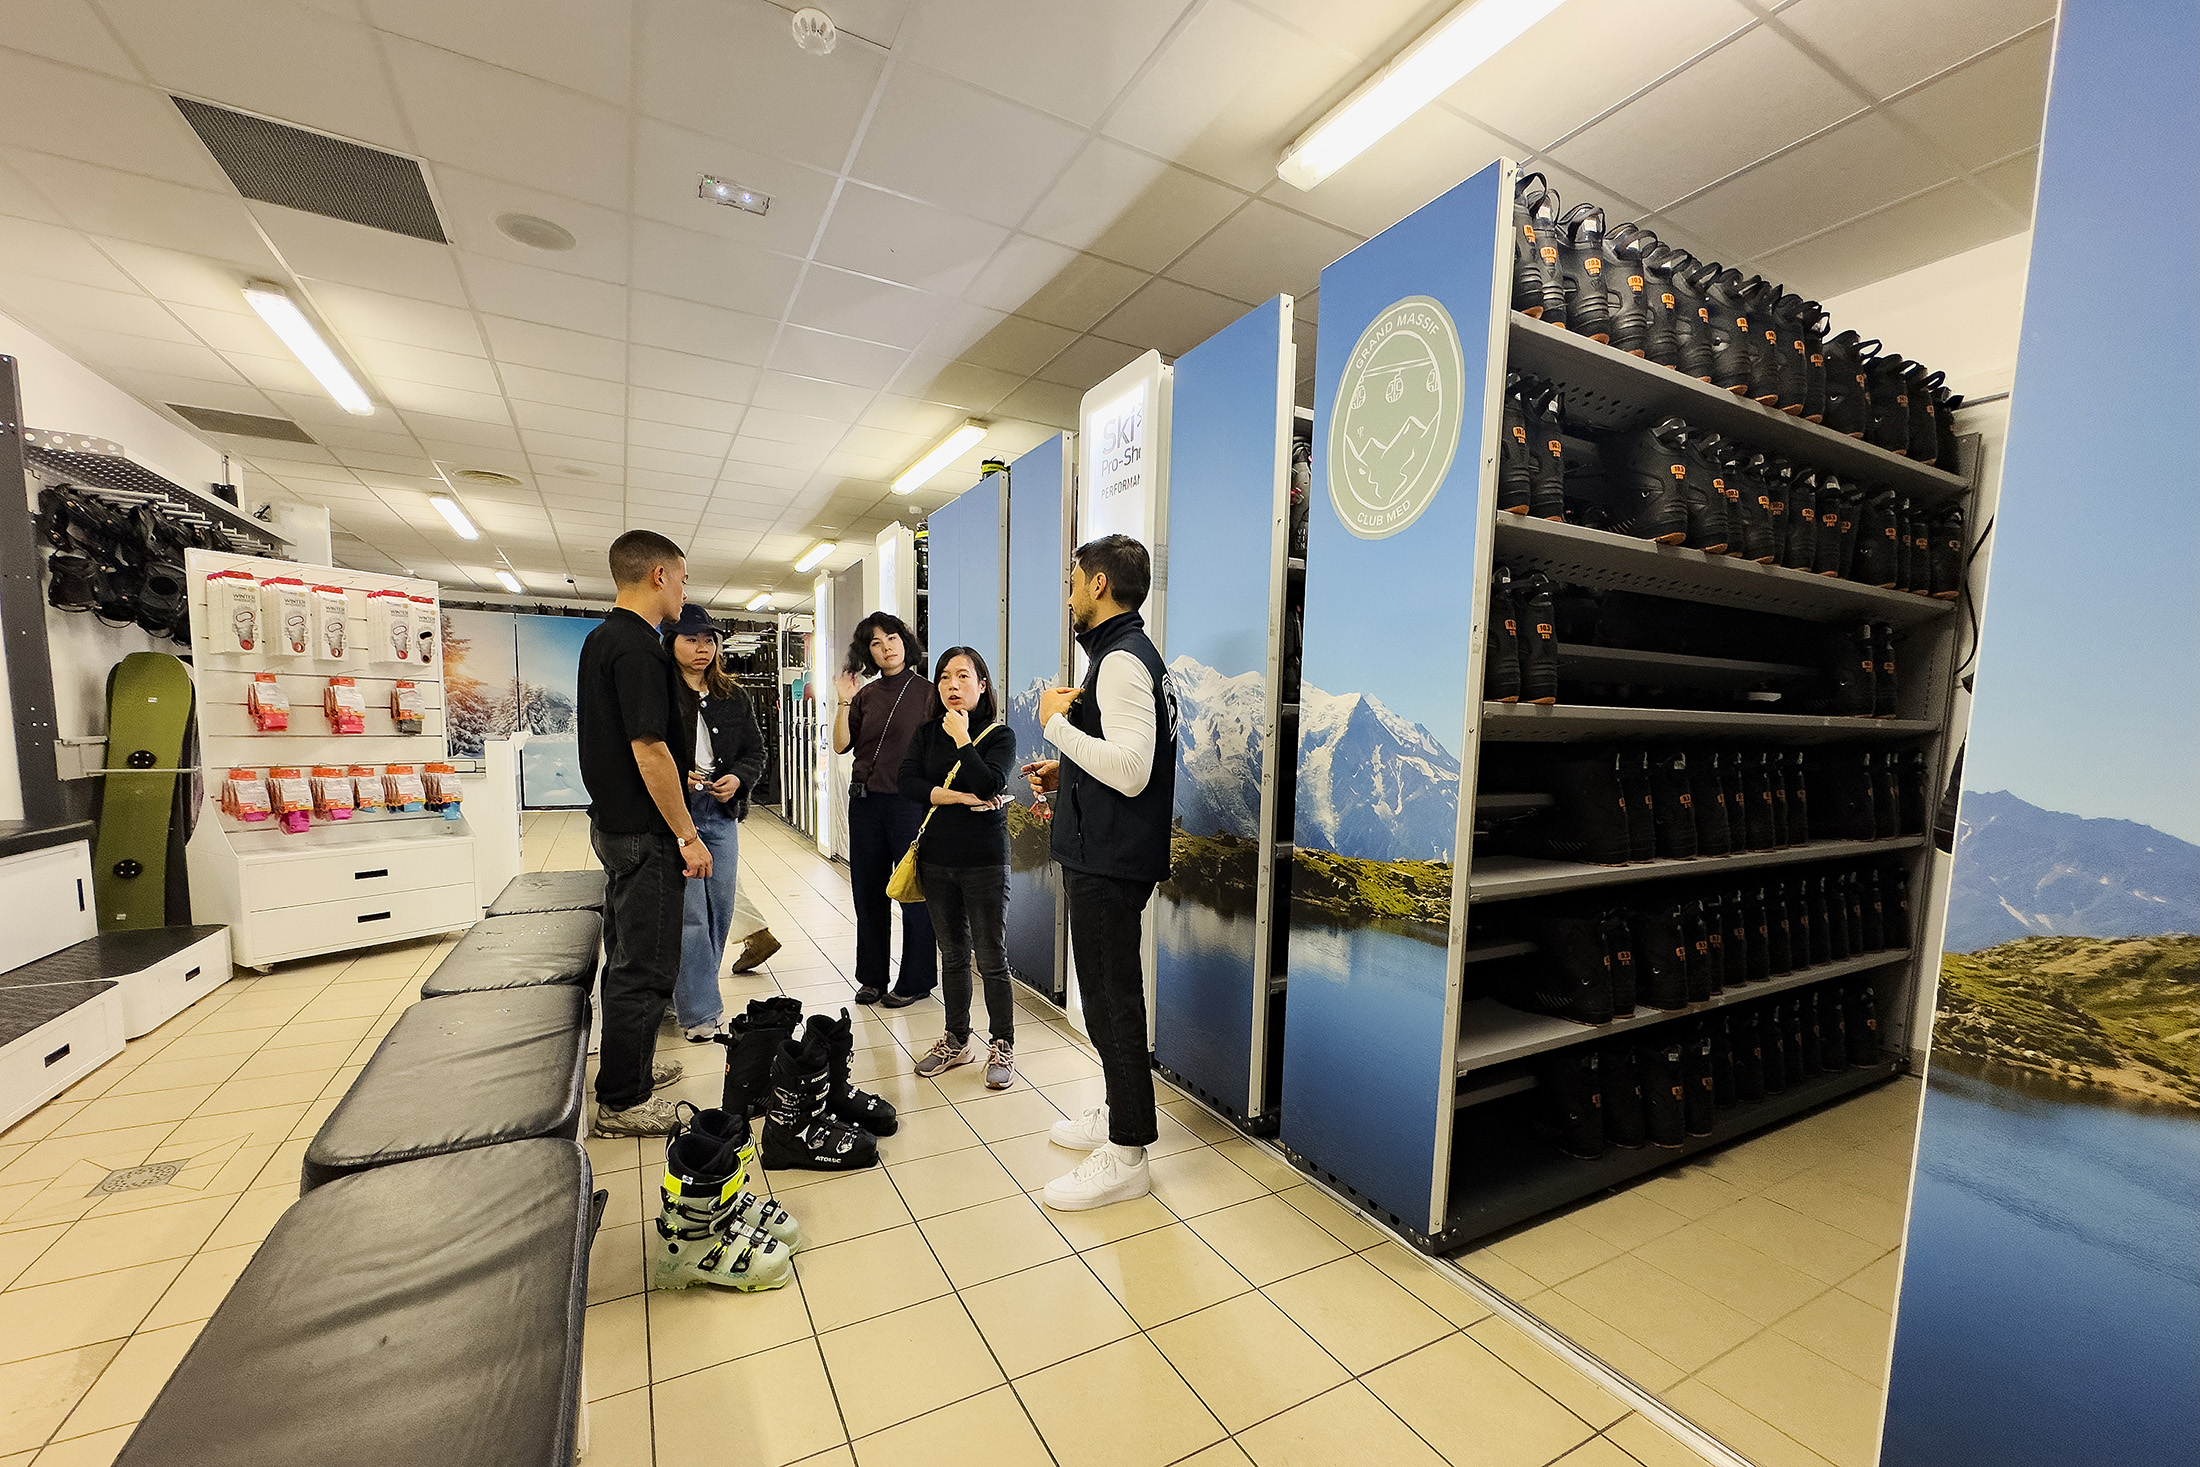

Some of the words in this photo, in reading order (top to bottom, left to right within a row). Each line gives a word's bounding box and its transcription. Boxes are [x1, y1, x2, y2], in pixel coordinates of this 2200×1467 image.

[1356, 321, 1393, 369] GRAND
[1396, 312, 1440, 335] MASSIF
[1357, 512, 1383, 526] CLUB
[1386, 500, 1410, 523] MED
[814, 1155, 842, 1163] ATOMIC
